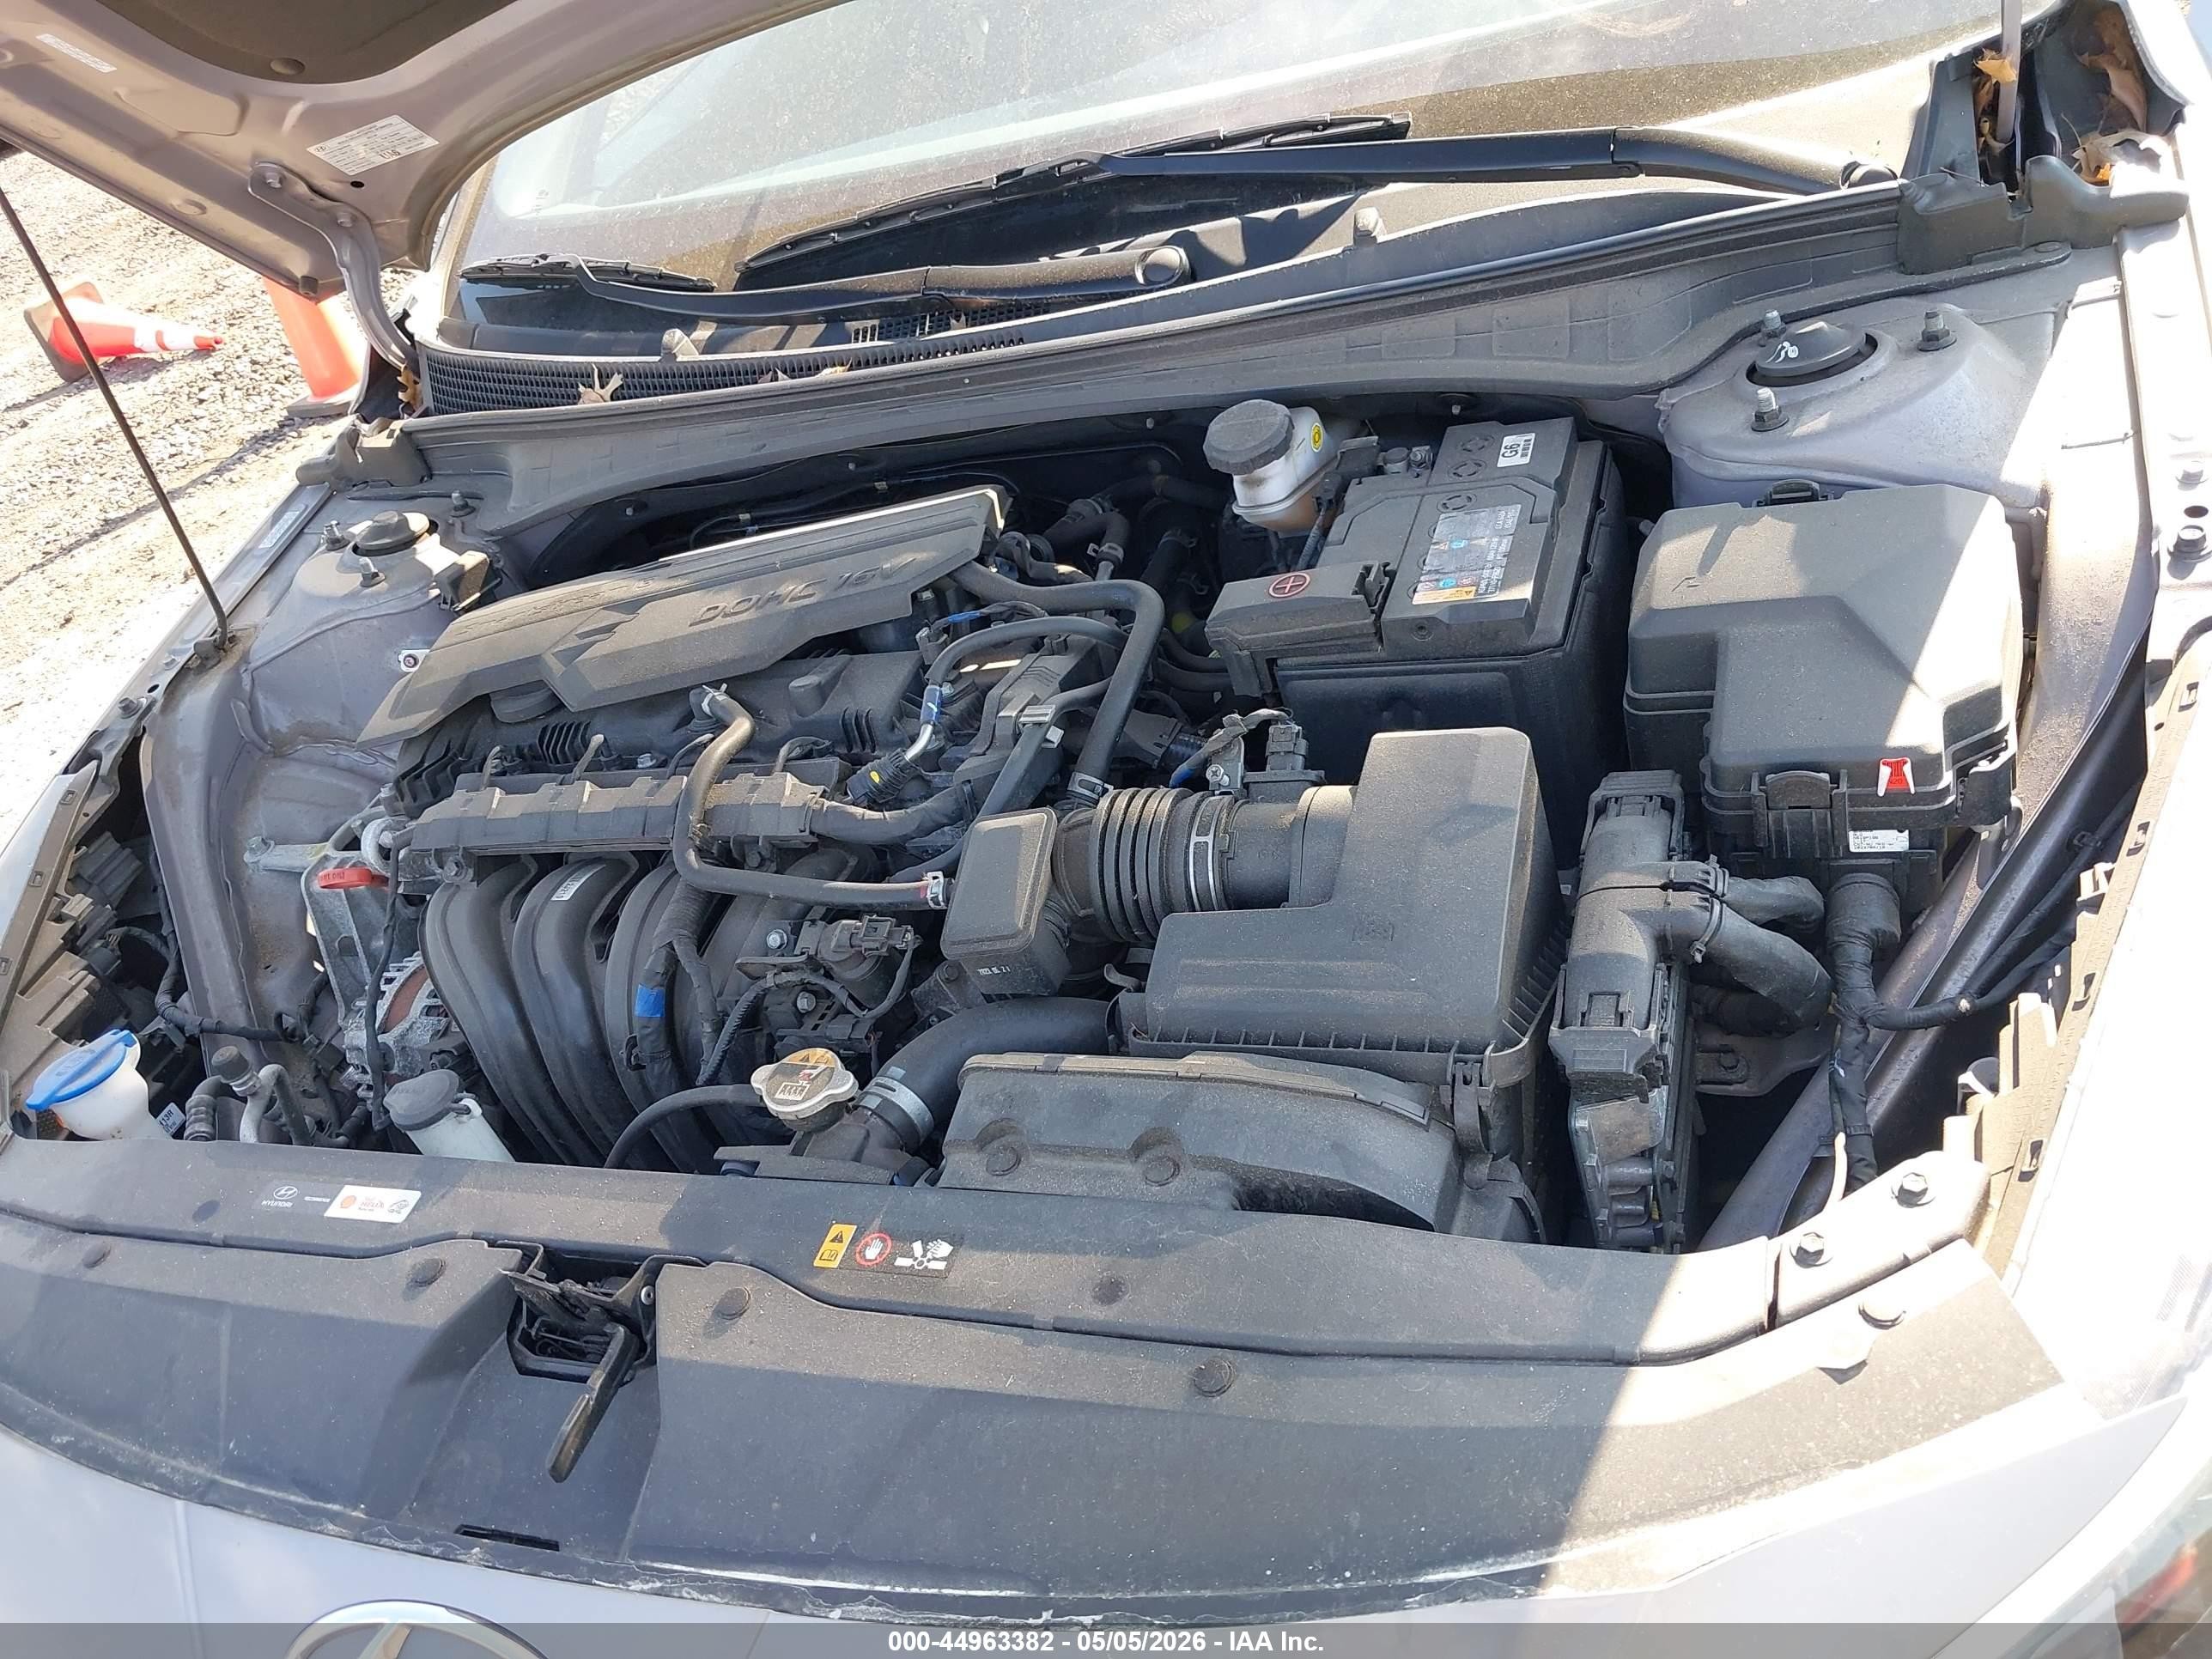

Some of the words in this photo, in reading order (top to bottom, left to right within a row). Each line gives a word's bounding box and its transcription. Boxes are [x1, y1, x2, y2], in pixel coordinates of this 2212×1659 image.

[1501, 443, 1521, 459] G6
[688, 578, 828, 628] DOHC
[833, 556, 919, 592] 16V
[261, 1200, 294, 1208] HYUNDAI
